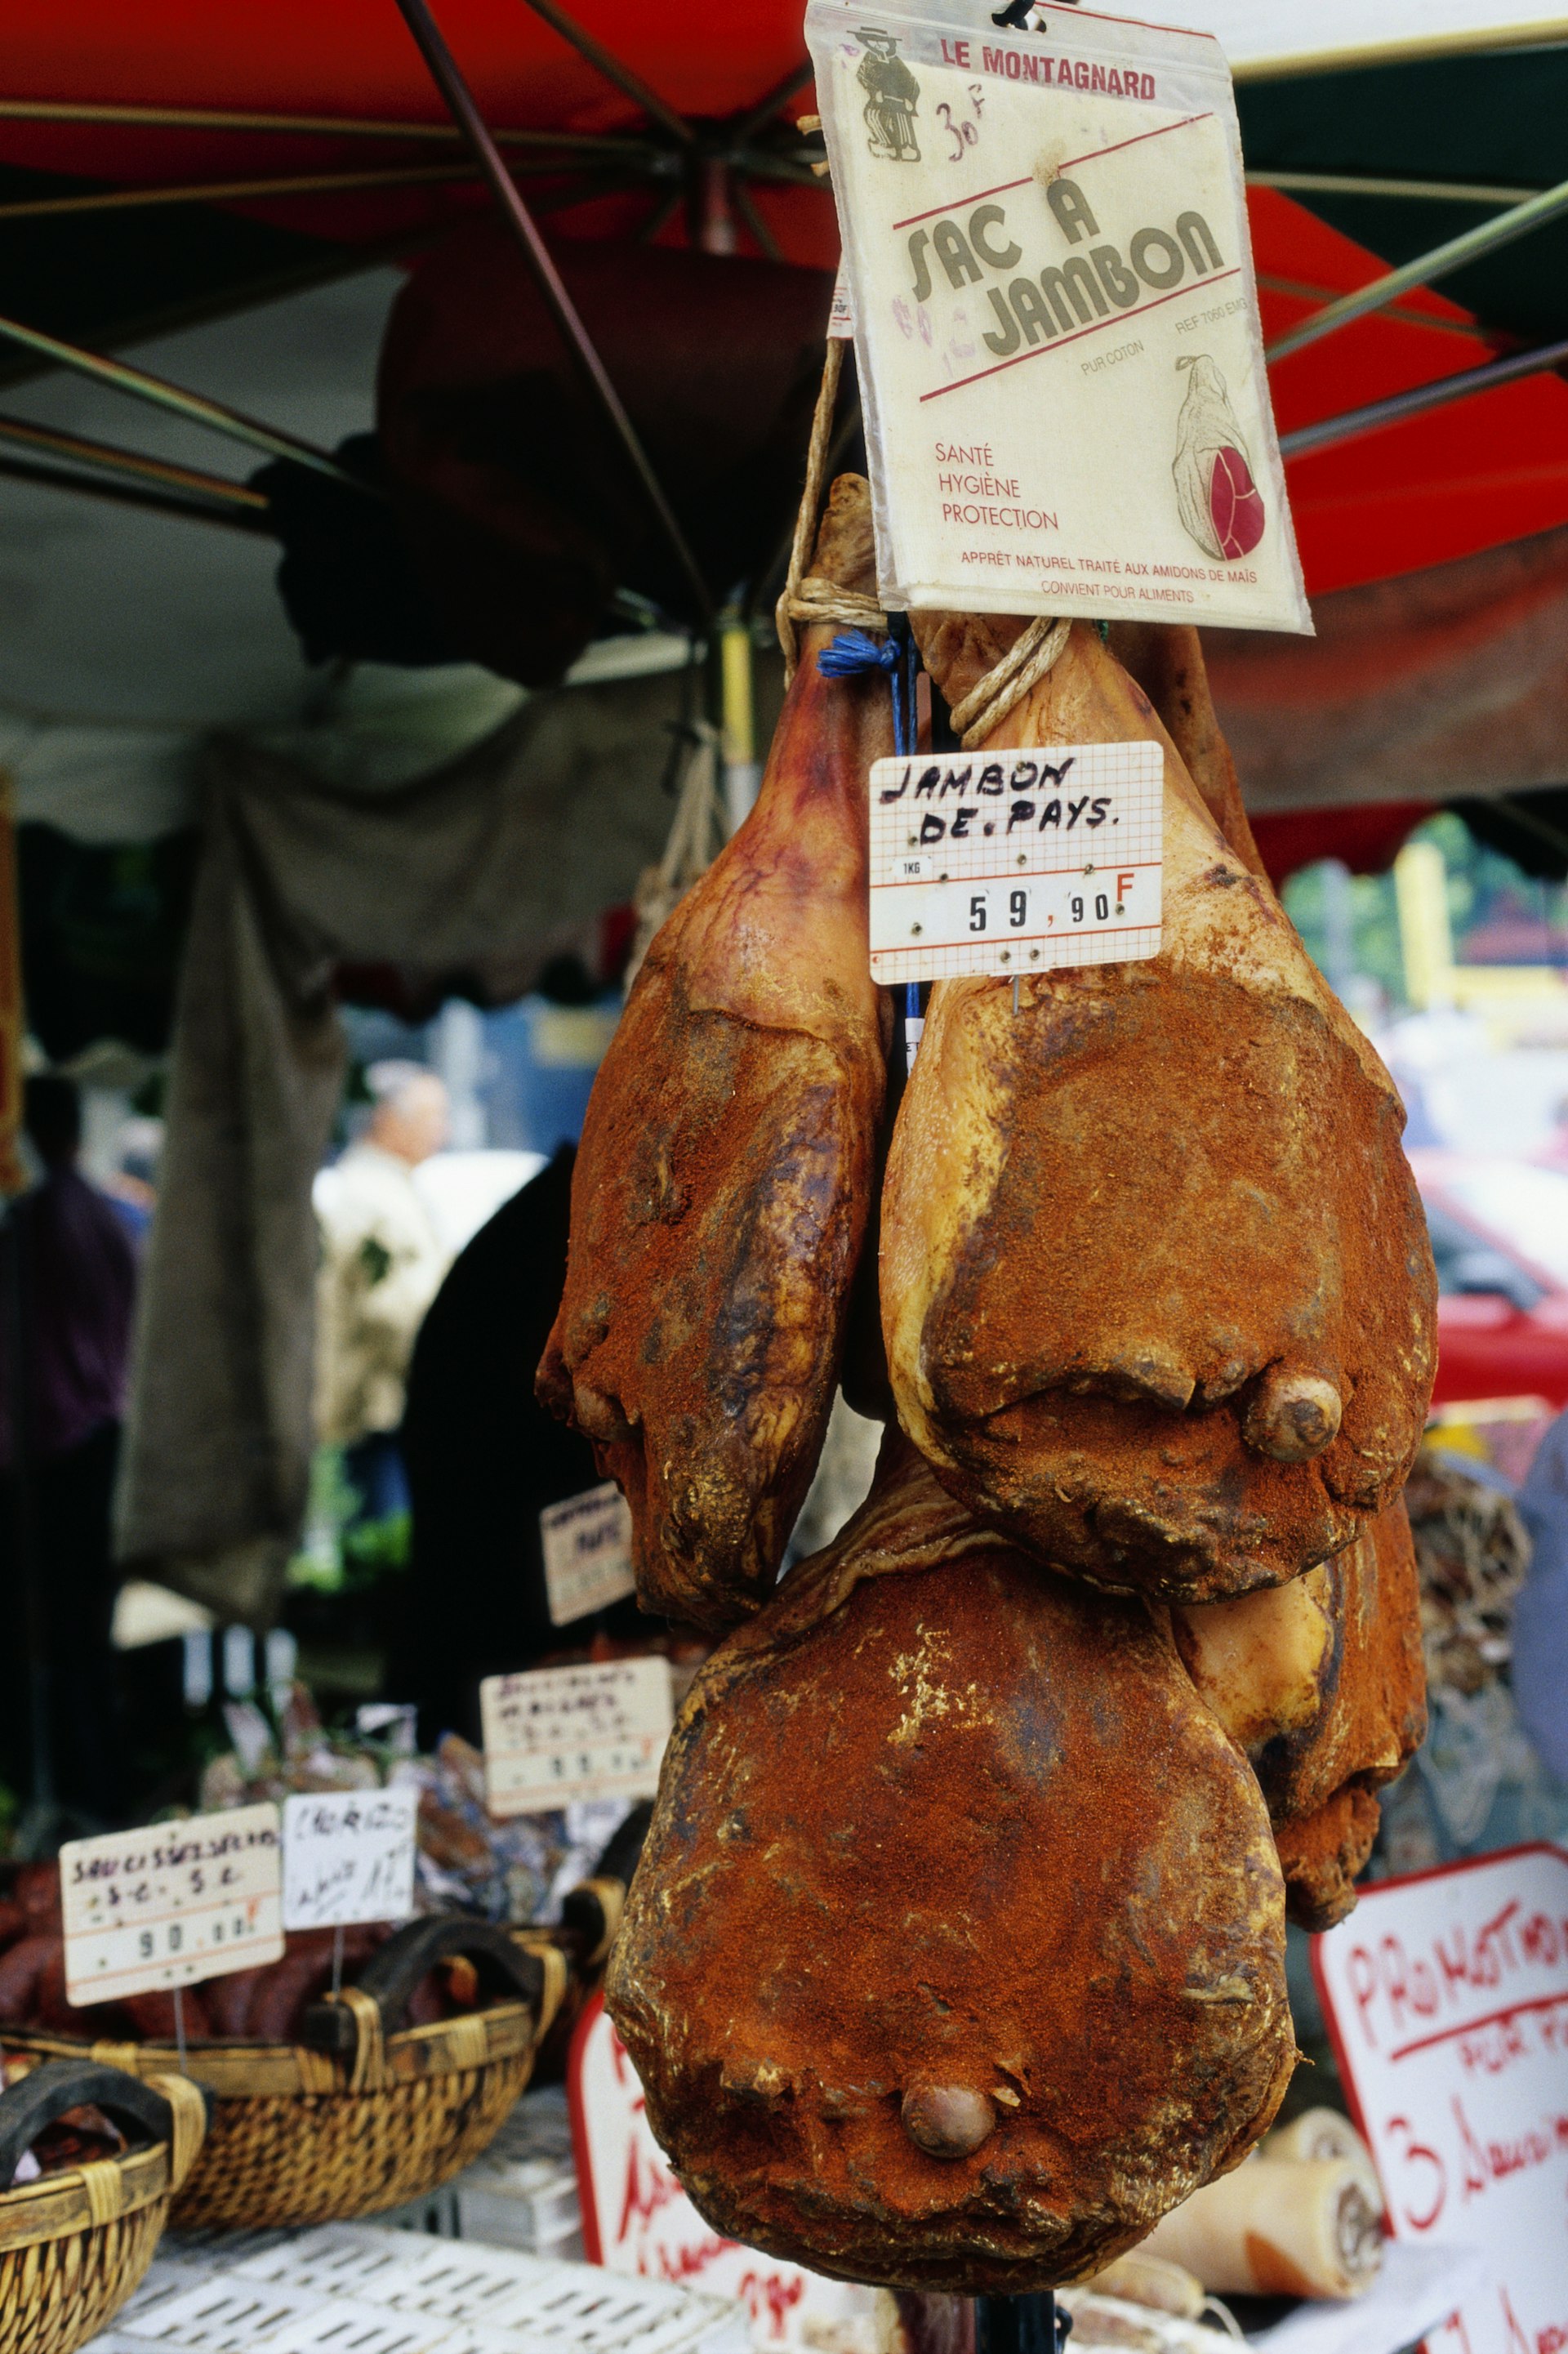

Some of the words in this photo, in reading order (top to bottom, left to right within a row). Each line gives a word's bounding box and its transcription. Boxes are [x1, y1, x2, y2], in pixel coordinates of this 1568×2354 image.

[941, 38, 971, 69] LE
[982, 46, 1156, 101] MONTAGNARD
[908, 204, 1022, 303] SAC
[1046, 178, 1101, 245] A
[982, 210, 1225, 357] JAMBON
[1175, 314, 1203, 335] REF
[1080, 356, 1107, 377] PUR
[1106, 339, 1145, 365] COTON
[935, 442, 994, 466] SANTÉ
[938, 471, 1021, 498] HYGIÈNE
[942, 503, 1059, 530] PROTECTION
[961, 550, 1012, 567] APPRÊT
[1016, 555, 1076, 570] NATUREL
[1078, 557, 1121, 574] TRAITÉ
[1125, 562, 1149, 576] AUX
[1152, 564, 1206, 581] AMIDONS
[1209, 569, 1225, 582] DE
[1227, 568, 1258, 583] MAÏS
[1041, 580, 1101, 596] CONVIENT
[1104, 585, 1135, 599] POUR
[1138, 588, 1195, 603] ALIMENTS
[880, 757, 1076, 805] JAMBON
[903, 862, 921, 875] 1KG
